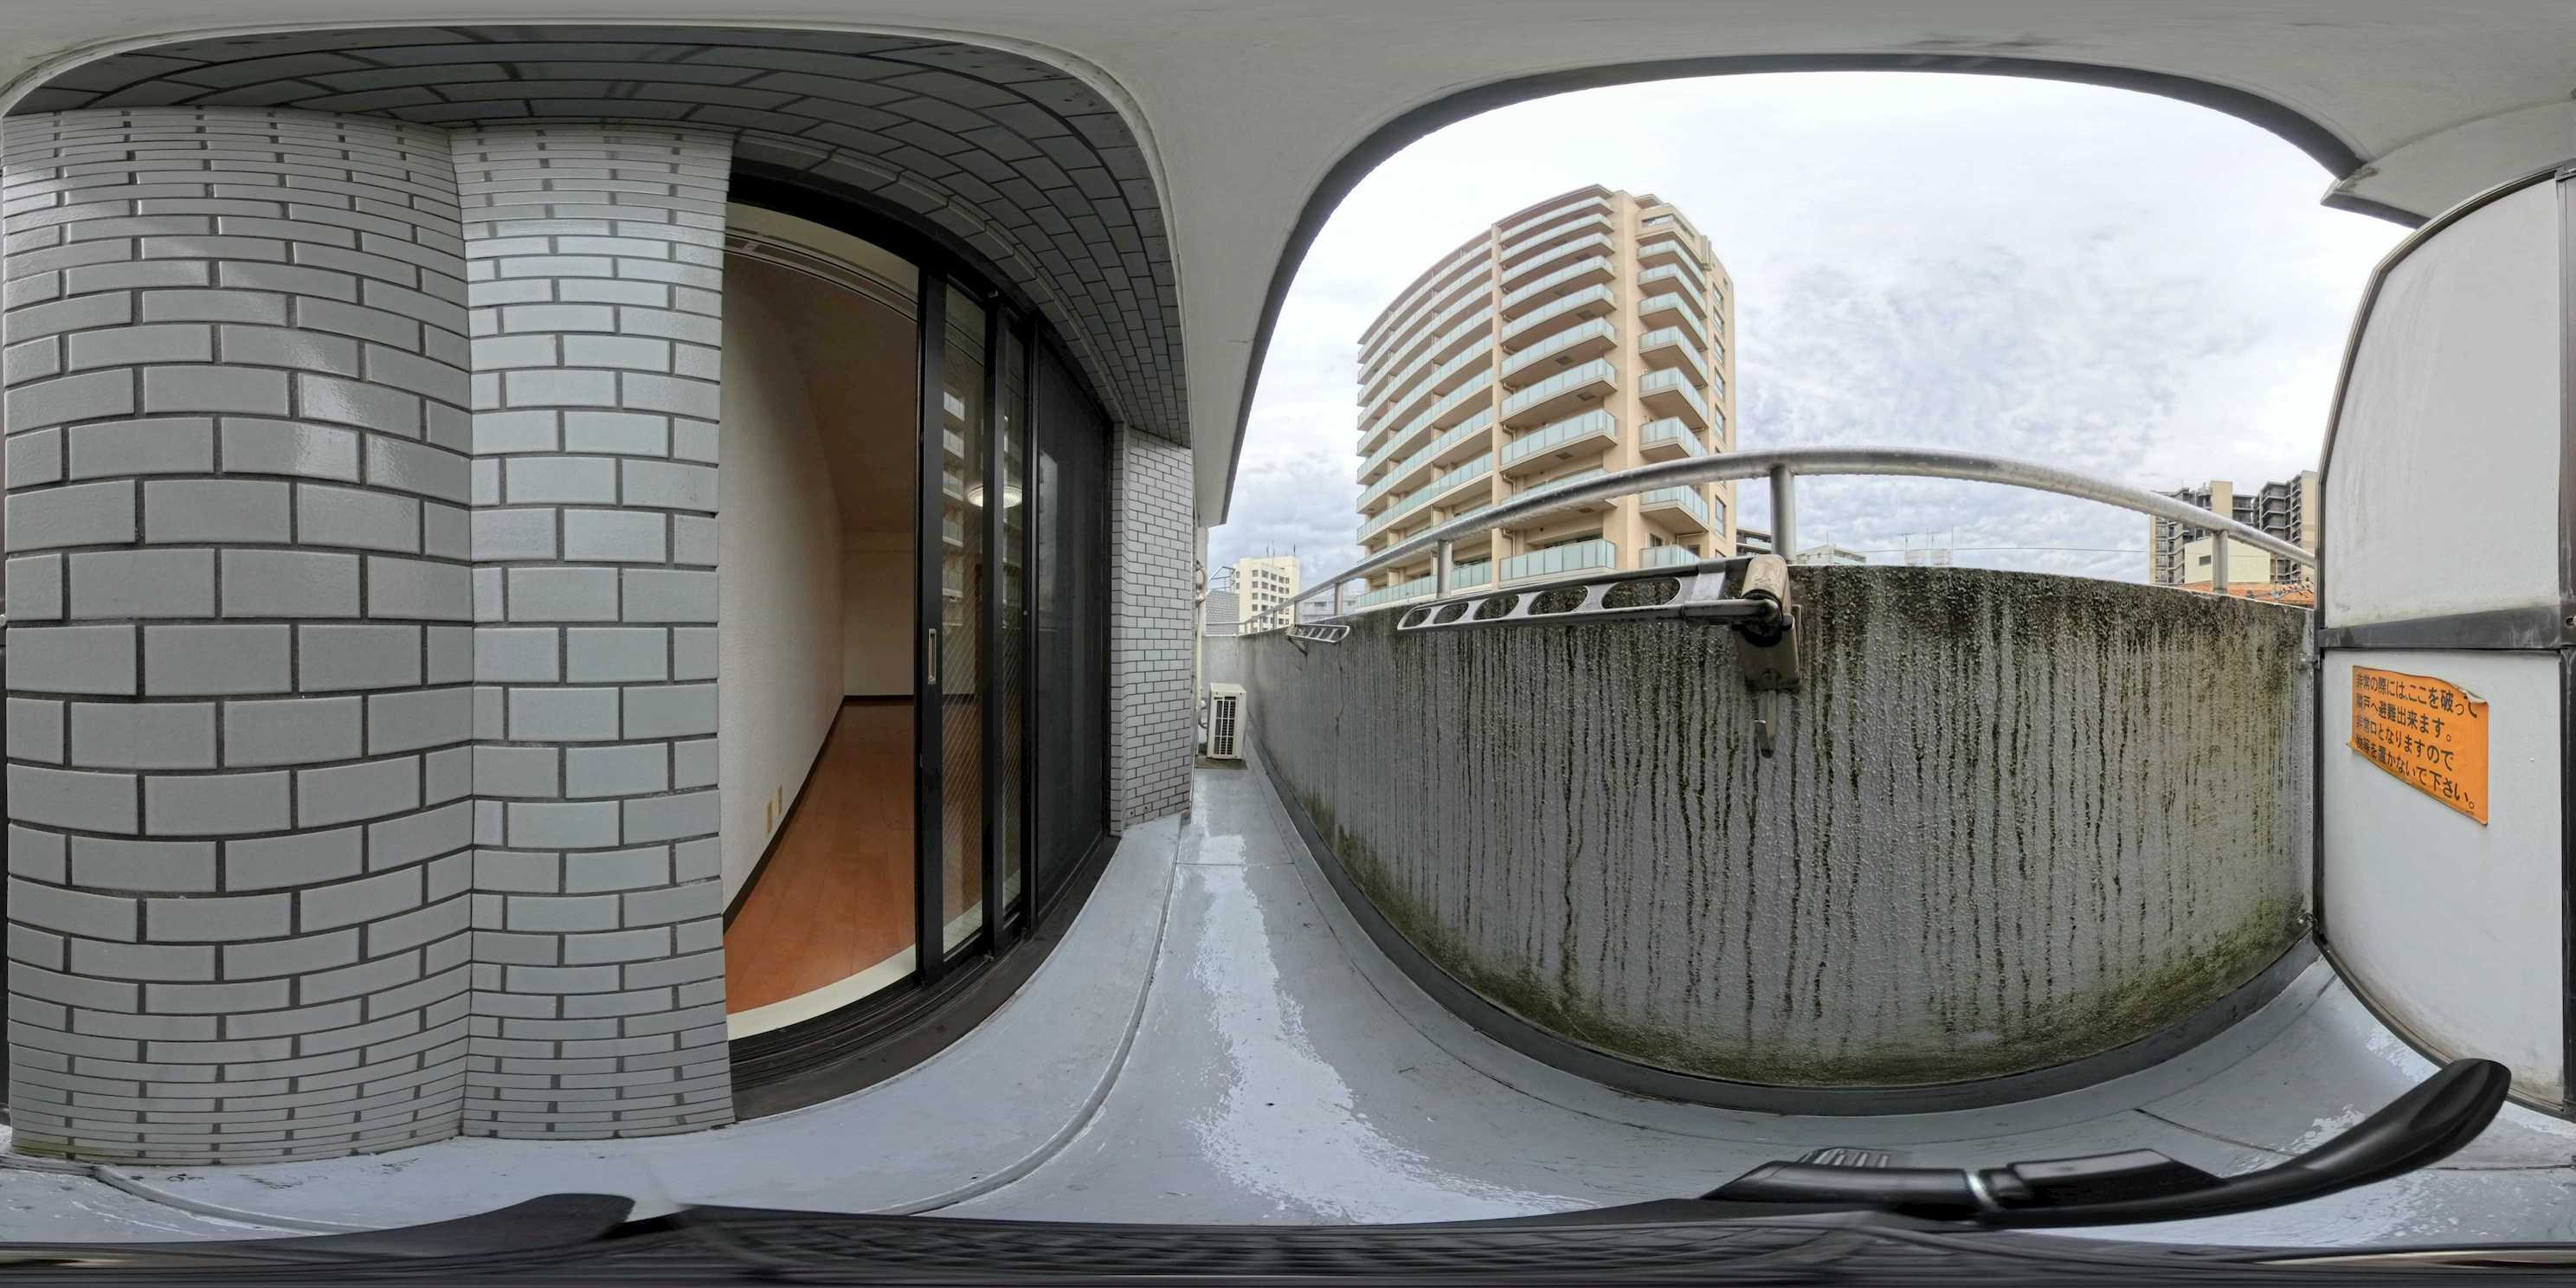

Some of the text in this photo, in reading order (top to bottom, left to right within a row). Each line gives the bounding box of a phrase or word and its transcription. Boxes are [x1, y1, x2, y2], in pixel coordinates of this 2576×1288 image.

[2355, 715, 2454, 771] 非常口となりますので
